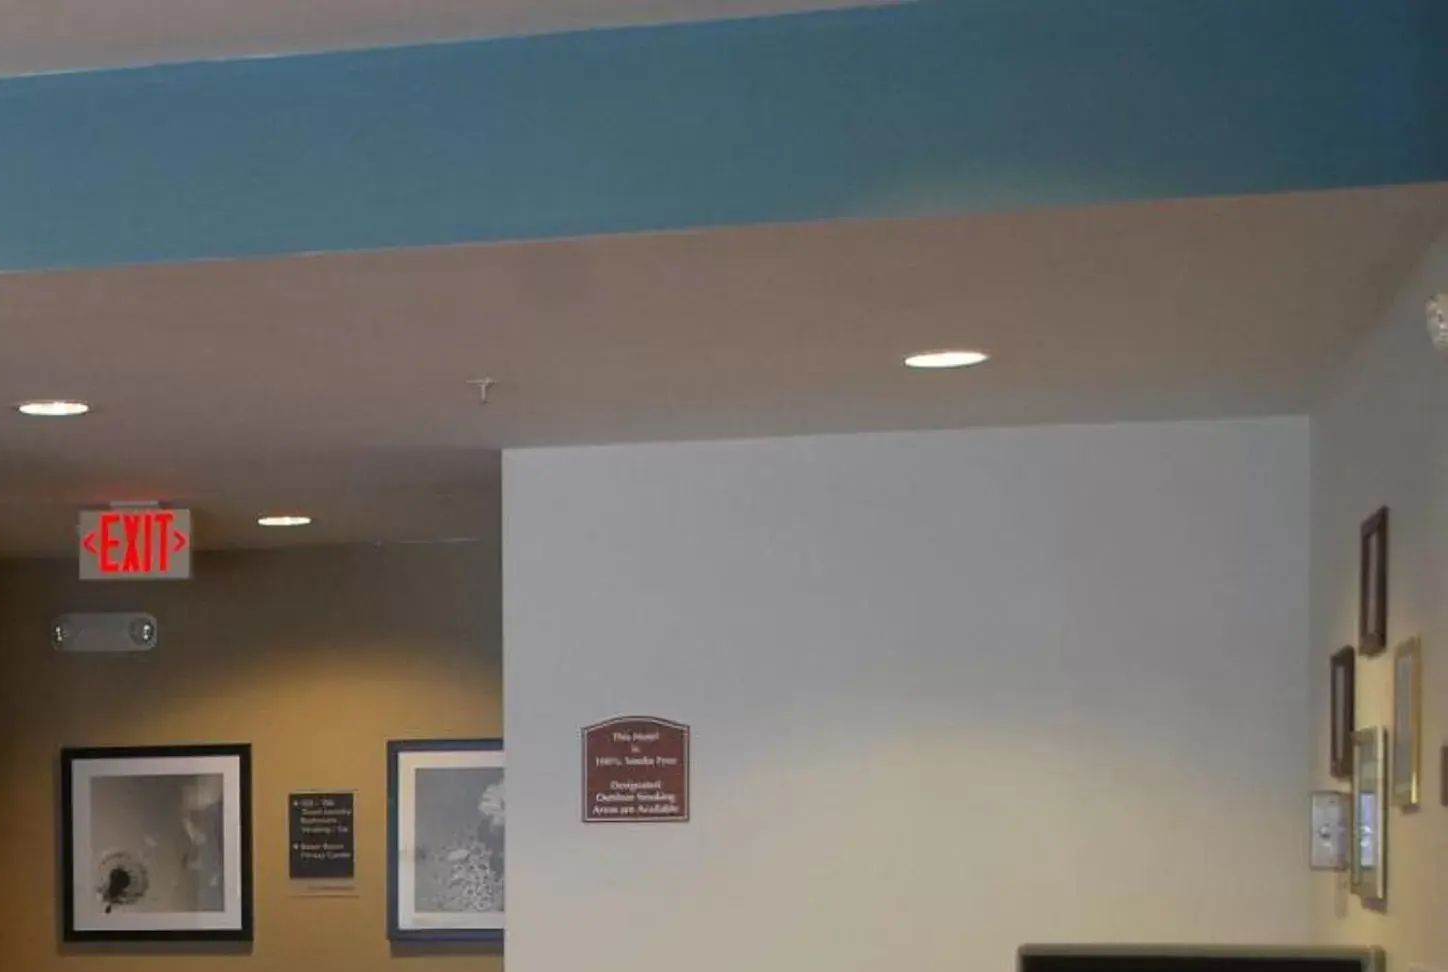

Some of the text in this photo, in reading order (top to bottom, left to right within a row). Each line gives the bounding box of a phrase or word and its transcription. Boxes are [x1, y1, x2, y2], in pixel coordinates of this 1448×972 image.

[99, 513, 174, 573] EXIT
[637, 792, 676, 803] Smoking
[638, 805, 679, 814] Available
